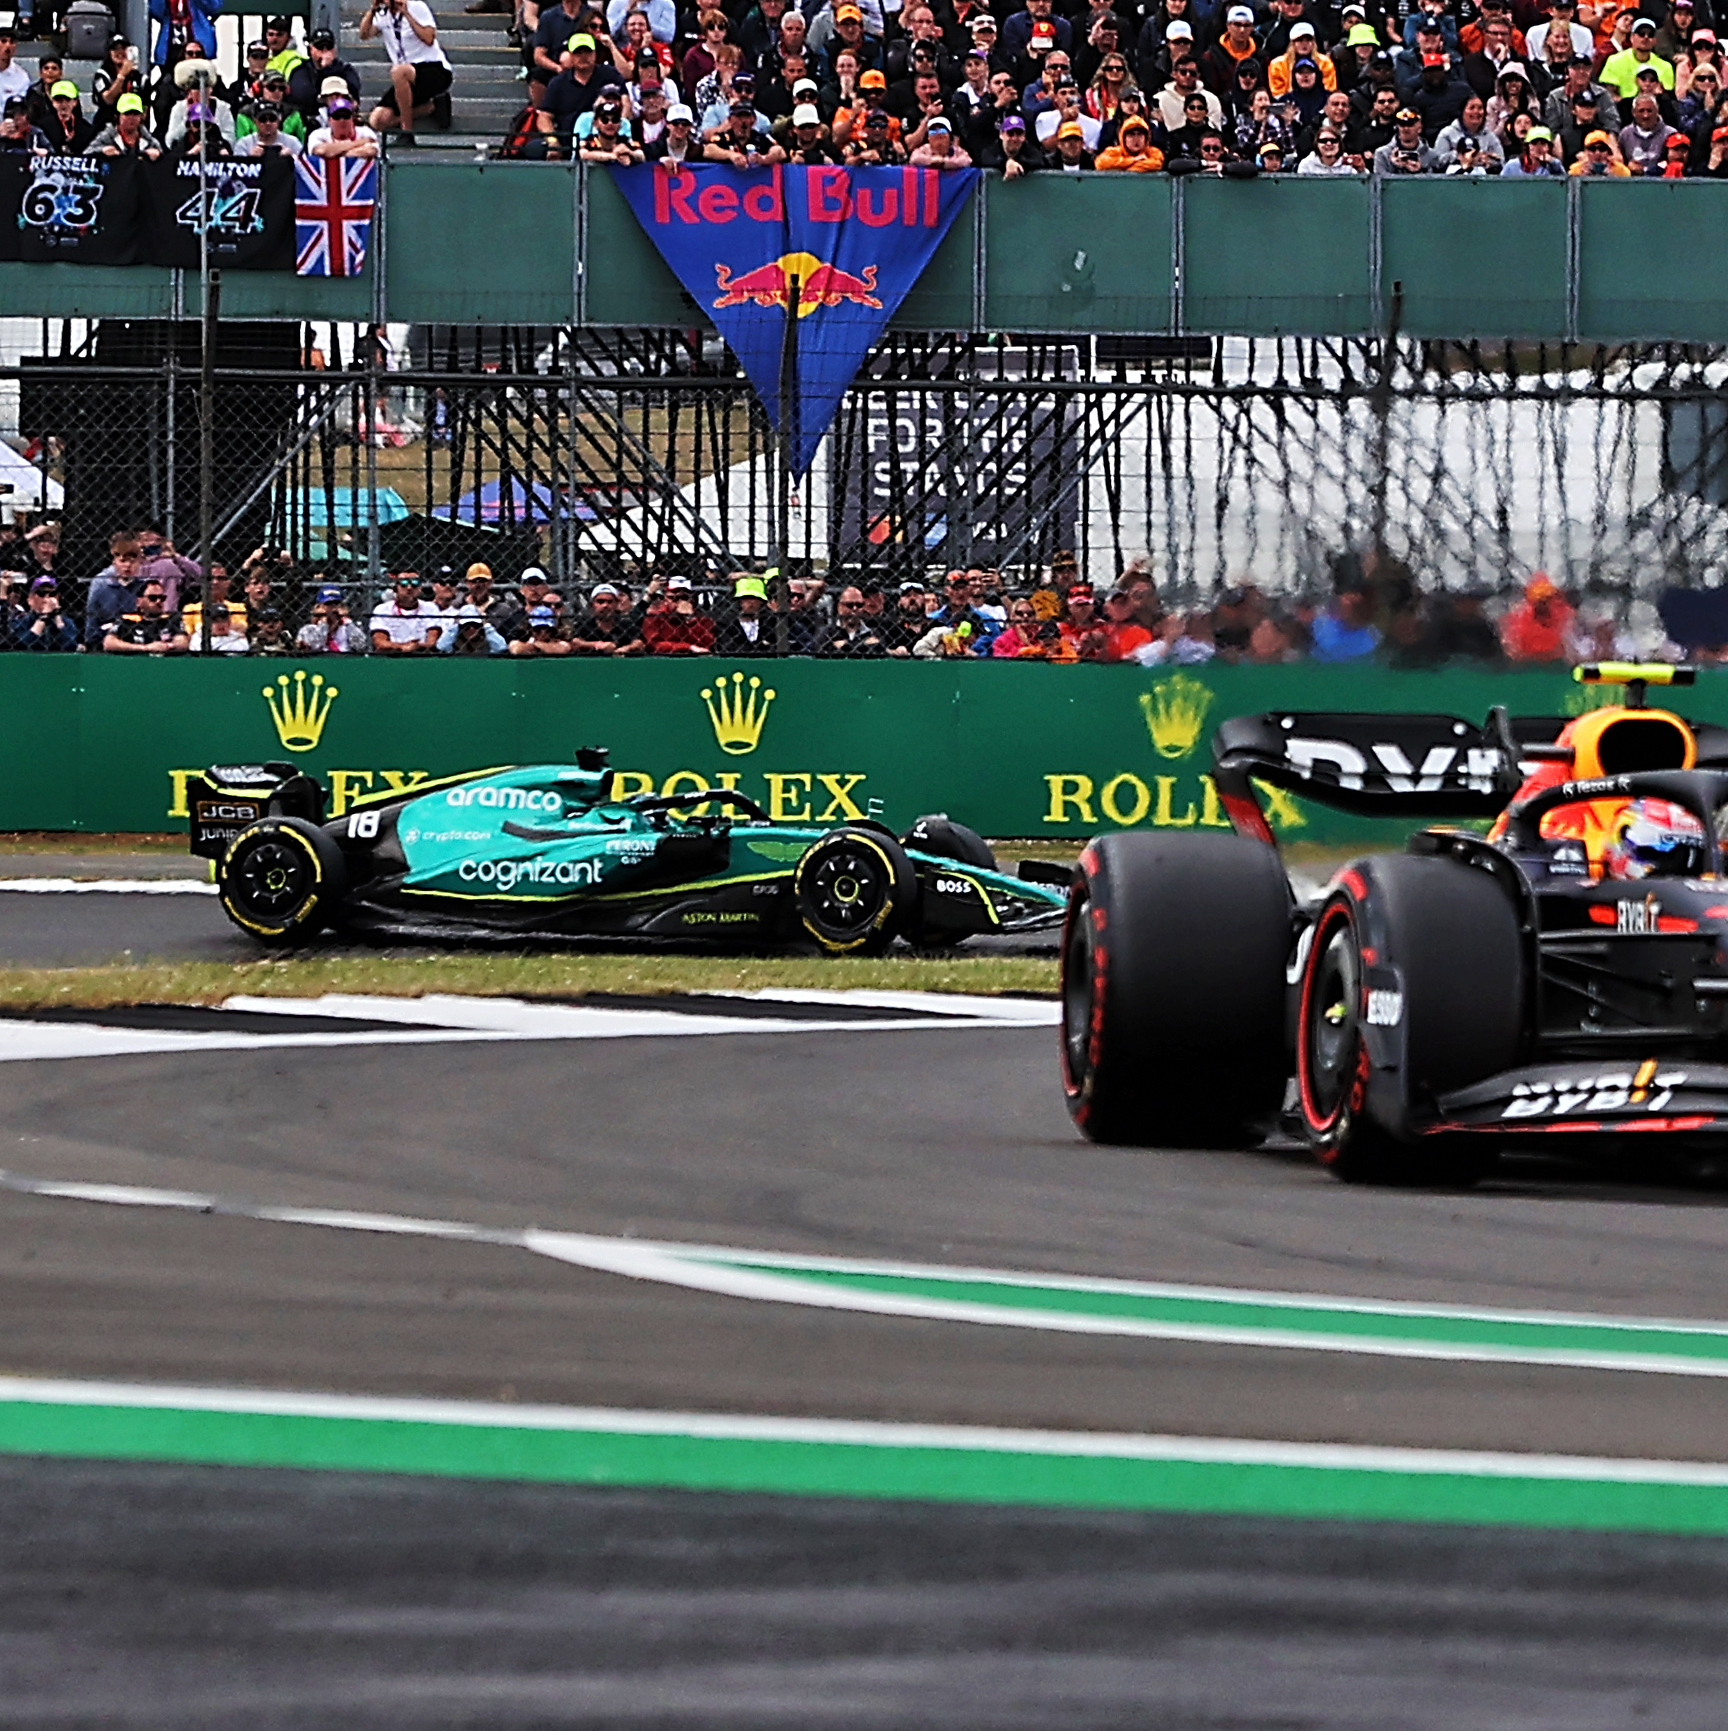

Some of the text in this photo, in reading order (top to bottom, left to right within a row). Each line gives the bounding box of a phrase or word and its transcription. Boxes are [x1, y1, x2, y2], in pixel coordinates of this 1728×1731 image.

[29, 155, 99, 173] RUSSELL
[176, 160, 262, 178] HAMILTON
[22, 181, 104, 227] 63
[653, 162, 940, 228] Red Bull
[175, 187, 264, 234] 44
[202, 804, 256, 820] JCB
[446, 786, 563, 812] aramco
[347, 810, 382, 839] 18
[458, 856, 604, 891] cognizant
[936, 879, 973, 893] BOSS
[681, 913, 716, 924] ASTON
